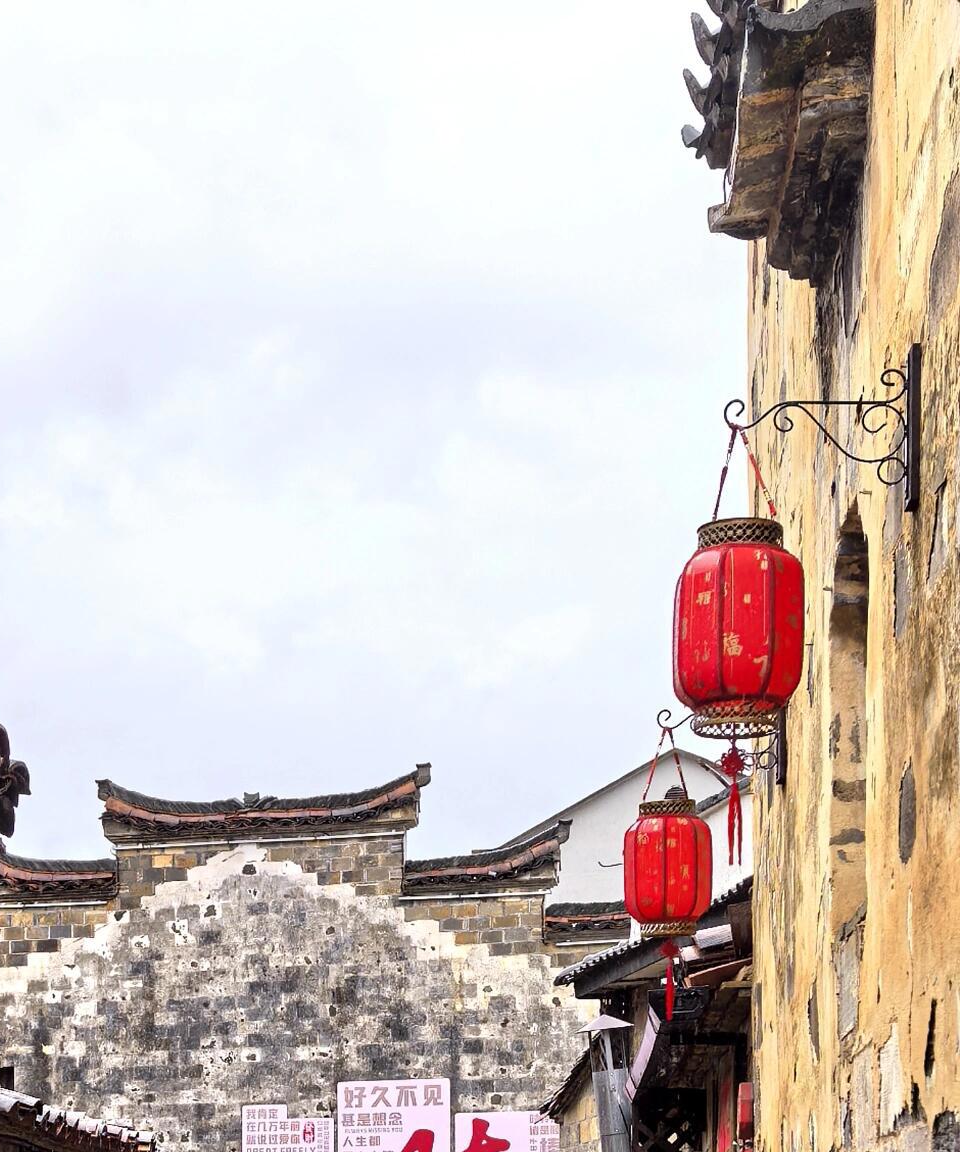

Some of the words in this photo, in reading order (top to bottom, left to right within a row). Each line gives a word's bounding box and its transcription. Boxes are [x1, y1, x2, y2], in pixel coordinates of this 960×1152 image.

[344, 1084, 444, 1108] 好久不见
[341, 1112, 403, 1127] 甚是想念
[246, 1121, 300, 1132] 在几万年前
[342, 1135, 381, 1147] 人生都
